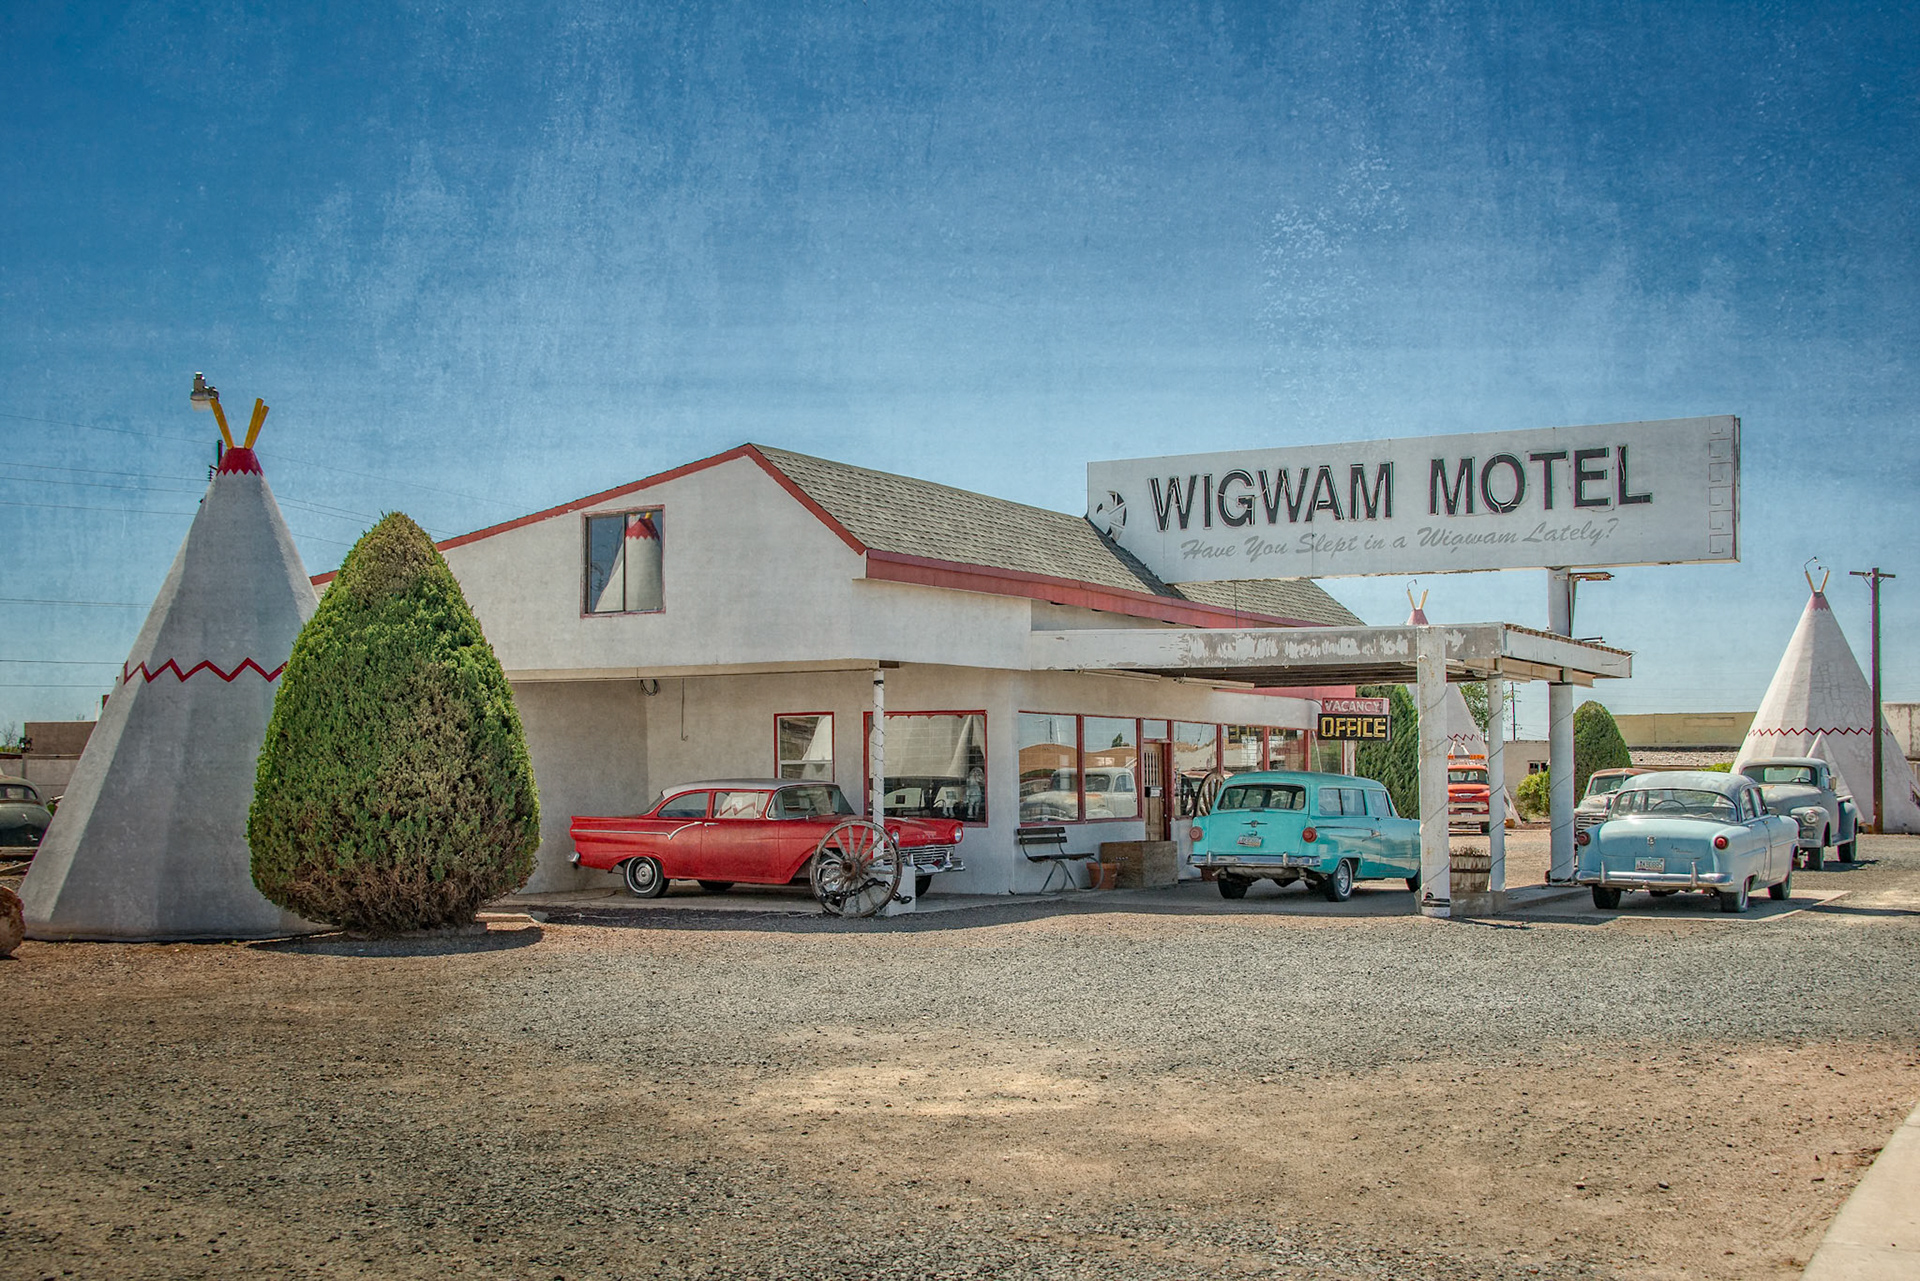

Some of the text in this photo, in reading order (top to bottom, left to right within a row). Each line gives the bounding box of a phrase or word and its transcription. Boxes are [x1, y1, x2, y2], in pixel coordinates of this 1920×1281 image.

[1149, 444, 1653, 532] WIGWAM MOTEL
[1181, 517, 1620, 563] Have You Slept in a Wigwam Lately?
[1325, 700, 1380, 712] VACANCY
[1321, 716, 1386, 738] OFFICE
